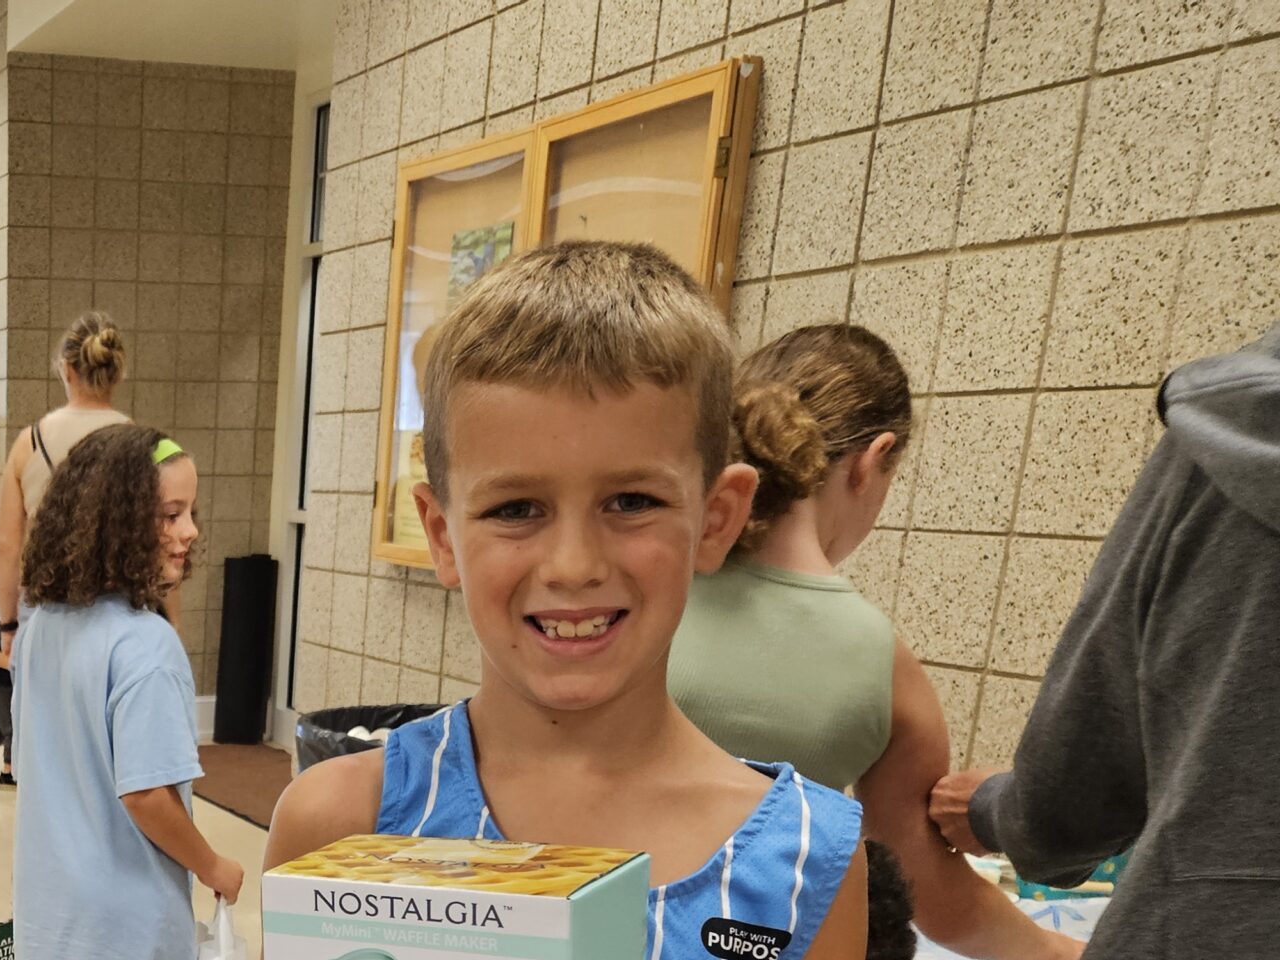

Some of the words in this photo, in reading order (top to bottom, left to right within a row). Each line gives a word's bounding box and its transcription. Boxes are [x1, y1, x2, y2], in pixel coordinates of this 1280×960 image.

[383, 928, 442, 946] WAFFLE
[444, 934, 498, 951] MAKER
[729, 927, 749, 938] PLAY
[750, 933, 776, 945] WITH
